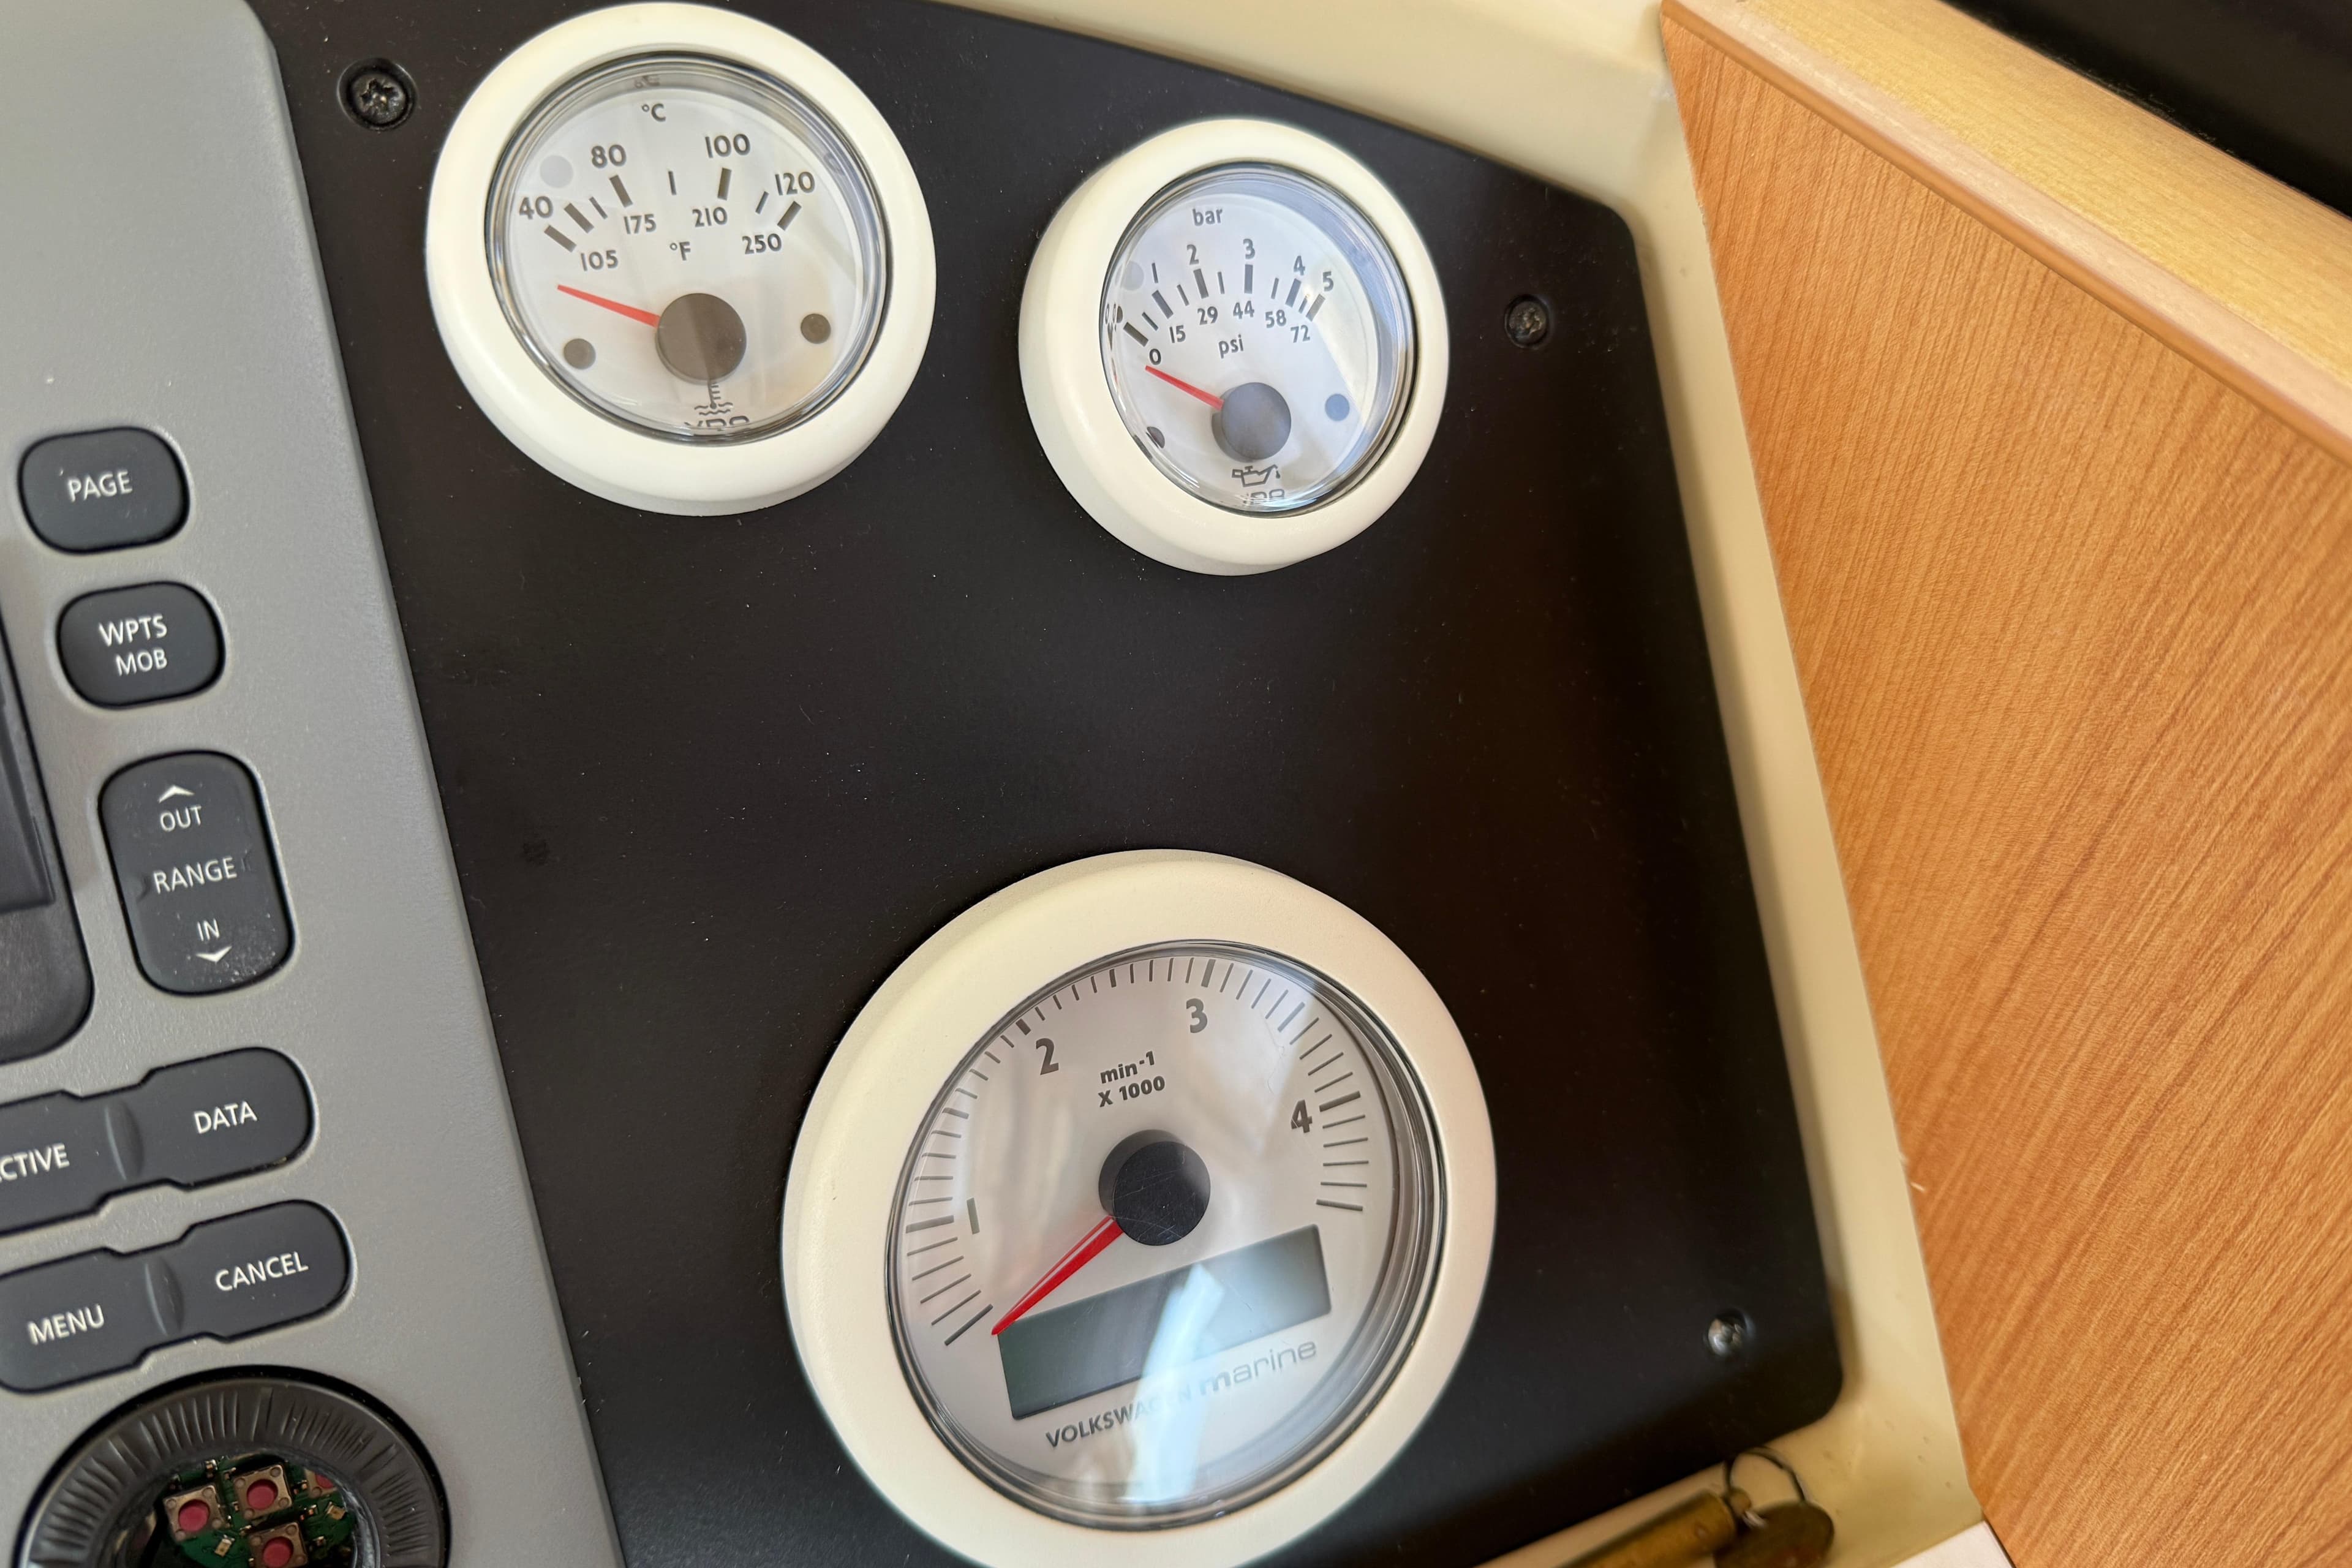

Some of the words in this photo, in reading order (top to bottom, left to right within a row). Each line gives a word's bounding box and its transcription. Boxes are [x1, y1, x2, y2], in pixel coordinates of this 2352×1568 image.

[641, 103, 666, 122] °C
[591, 143, 627, 168] 80
[705, 134, 751, 158] 100
[775, 171, 816, 196] 120
[518, 195, 553, 220] 40
[692, 206, 728, 227] 210
[1193, 207, 1224, 227] bar
[623, 214, 657, 235] 175
[669, 241, 692, 261] °F
[742, 233, 782, 254] 250
[1186, 244, 1199, 265] 2
[1243, 238, 1256, 259] 3
[580, 249, 619, 271] 105
[1293, 255, 1306, 277] 4
[1322, 271, 1334, 292] 5
[1197, 306, 1218, 325] 29
[1232, 300, 1255, 320] 44
[1265, 309, 1286, 329] 58
[1169, 325, 1186, 344] 15
[1218, 334, 1245, 358] psi
[1291, 325, 1311, 343] 72
[1149, 349, 1162, 366] 0
[67, 469, 133, 503] PAGE
[99, 614, 167, 647] WPTS
[115, 647, 168, 677] MOB
[159, 805, 202, 832] OUT
[153, 857, 238, 894] RANGE
[197, 918, 221, 941] IN
[1186, 998, 1208, 1033] 3
[1035, 1038, 1059, 1076] 2
[1118, 1076, 1166, 1101] 1000
[194, 1101, 258, 1134] DATA
[1291, 1099, 1313, 1133] 4
[0, 1142, 70, 1183] CTIVE
[215, 1251, 309, 1292] CANCEL
[27, 1304, 105, 1345] MENU
[1200, 1341, 1317, 1396] marine
